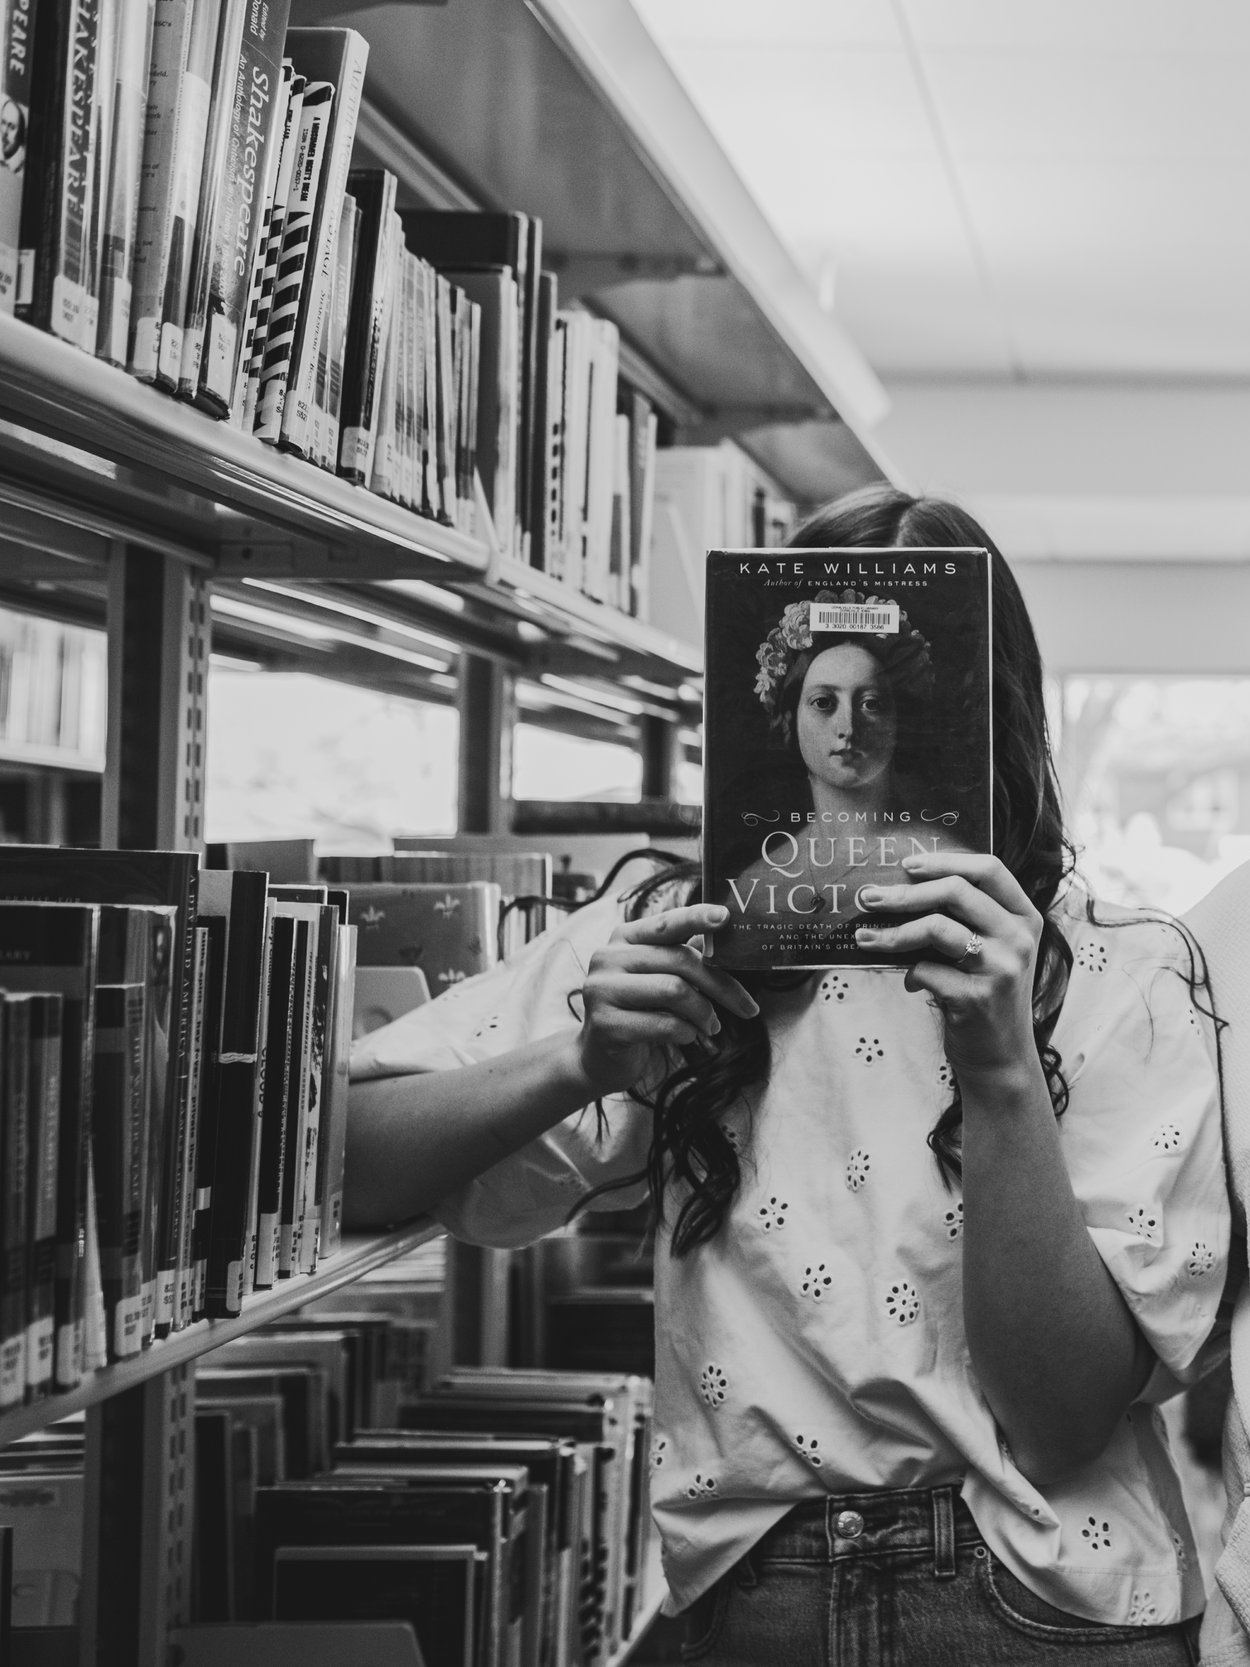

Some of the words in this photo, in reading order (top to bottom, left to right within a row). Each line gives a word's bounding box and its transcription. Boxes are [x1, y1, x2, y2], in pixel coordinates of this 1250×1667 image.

[232, 73, 247, 123] Anthology
[307, 122, 321, 158] MIDSUMMER
[234, 66, 269, 276] Shakespeare
[303, 159, 314, 181] NIGHT'S
[299, 182, 311, 202] DREAM
[739, 562, 805, 575] KATE
[823, 562, 958, 575] WILLIAMS
[764, 578, 792, 587] Author
[793, 578, 804, 588] of
[807, 579, 869, 587] ENGLAND'S
[790, 811, 912, 823] BECOMING
[761, 830, 941, 878] QUEEN
[725, 878, 884, 914] VICTO
[184, 894, 196, 969] DIVIDED
[732, 923, 752, 931] THE
[756, 923, 794, 931] TRAGIC
[798, 923, 832, 931] DEATH
[836, 923, 850, 931] OF
[778, 933, 800, 941] AND
[761, 943, 775, 951] OF
[779, 942, 831, 951] BRITAIN'S
[177, 977, 191, 1059] AMERICA
